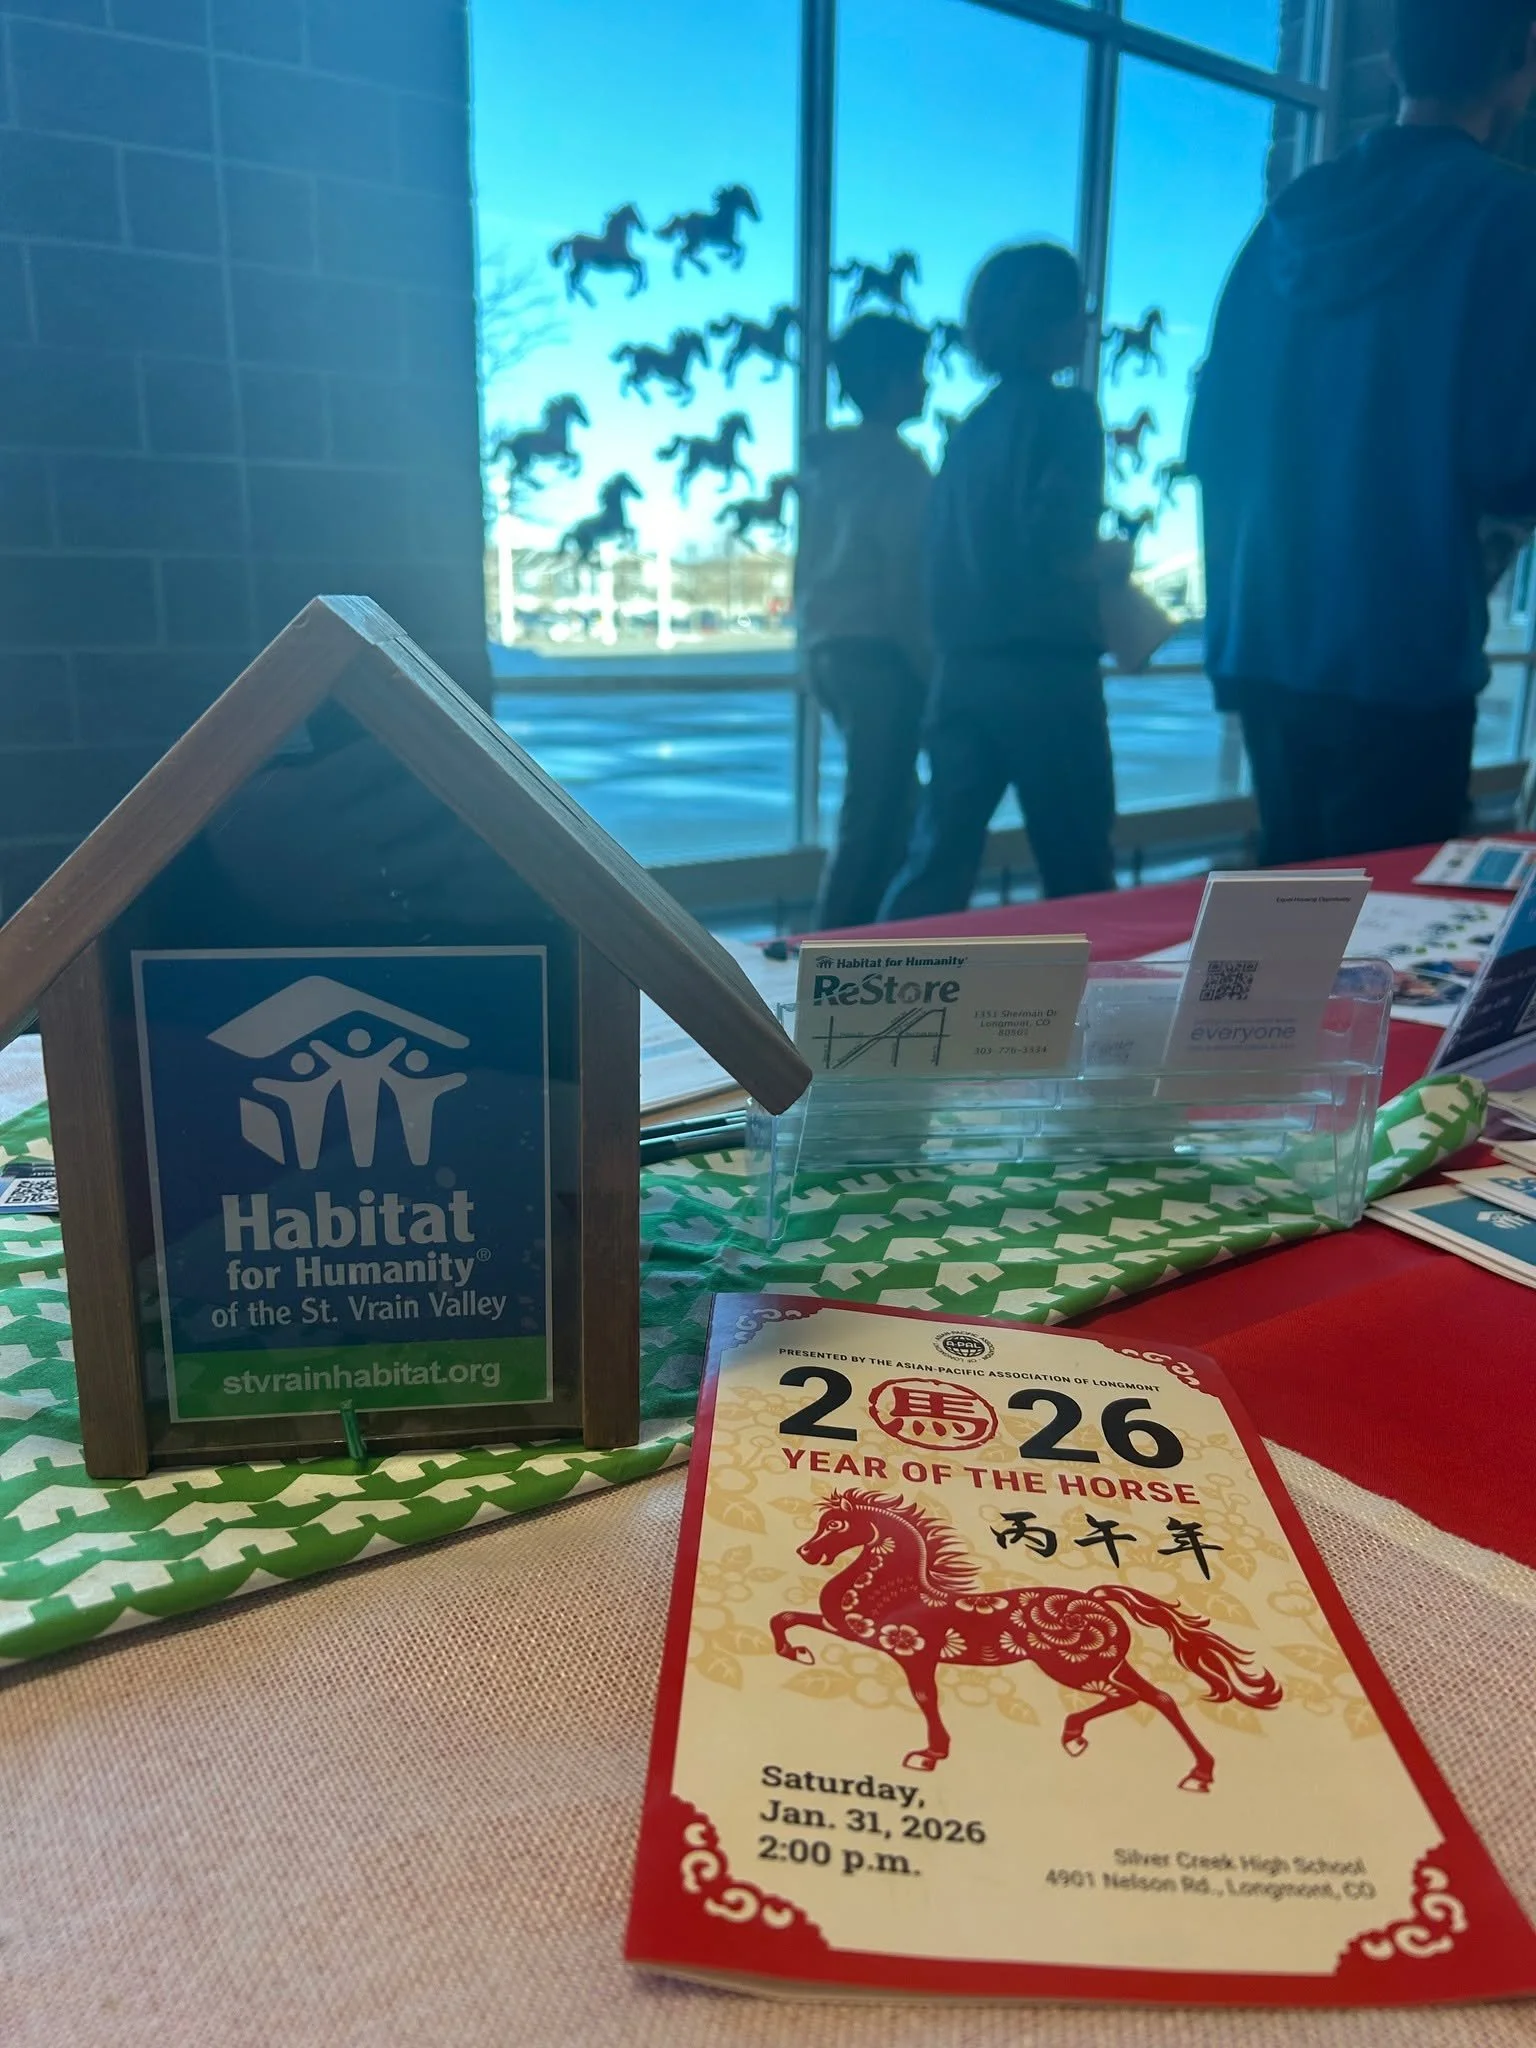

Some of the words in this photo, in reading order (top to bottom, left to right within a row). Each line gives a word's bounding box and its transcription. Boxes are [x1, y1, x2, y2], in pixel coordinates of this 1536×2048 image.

[837, 957, 882, 968] Habitat
[886, 957, 902, 967] for
[906, 956, 965, 967] Humanity
[813, 973, 960, 1006] ReStore
[1190, 1026, 1296, 1044] everyone
[221, 1188, 475, 1252] Habitat
[226, 1260, 281, 1291] for
[211, 1301, 239, 1328] of
[247, 1300, 291, 1327] the
[302, 1297, 338, 1323] St.
[348, 1294, 419, 1322] Vrain
[427, 1290, 507, 1321] Valley
[222, 1361, 502, 1395] stvrainhabitat.org
[779, 1348, 848, 1361] PRESENTED
[869, 1358, 892, 1366] THE
[896, 1361, 985, 1377] ASIAN-PACIFIC
[989, 1370, 1071, 1383] ASSOCIATION
[1092, 1379, 1161, 1392] LONGMONT
[781, 1447, 888, 1480] YEAR
[902, 1461, 955, 1485] OF
[964, 1467, 1048, 1495] THE
[1058, 1475, 1201, 1505] HORSE
[989, 1511, 1224, 1581] 丙午年
[761, 1765, 925, 1808] Saturday,
[759, 1800, 836, 1829] Jan.
[846, 1808, 892, 1839] 31,
[901, 1815, 986, 1844] 2026
[757, 1835, 831, 1867] 2:00
[841, 1849, 921, 1877] p.m.
[1113, 1848, 1170, 1867] Silver
[1175, 1850, 1236, 1871] Creek
[1239, 1855, 1290, 1876] High
[1292, 1856, 1368, 1876] School
[1045, 1868, 1096, 1889] 4901
[1102, 1872, 1177, 1894] Nelson
[1225, 1877, 1342, 1902] Longmont,
[1342, 1880, 1377, 1900] CO
